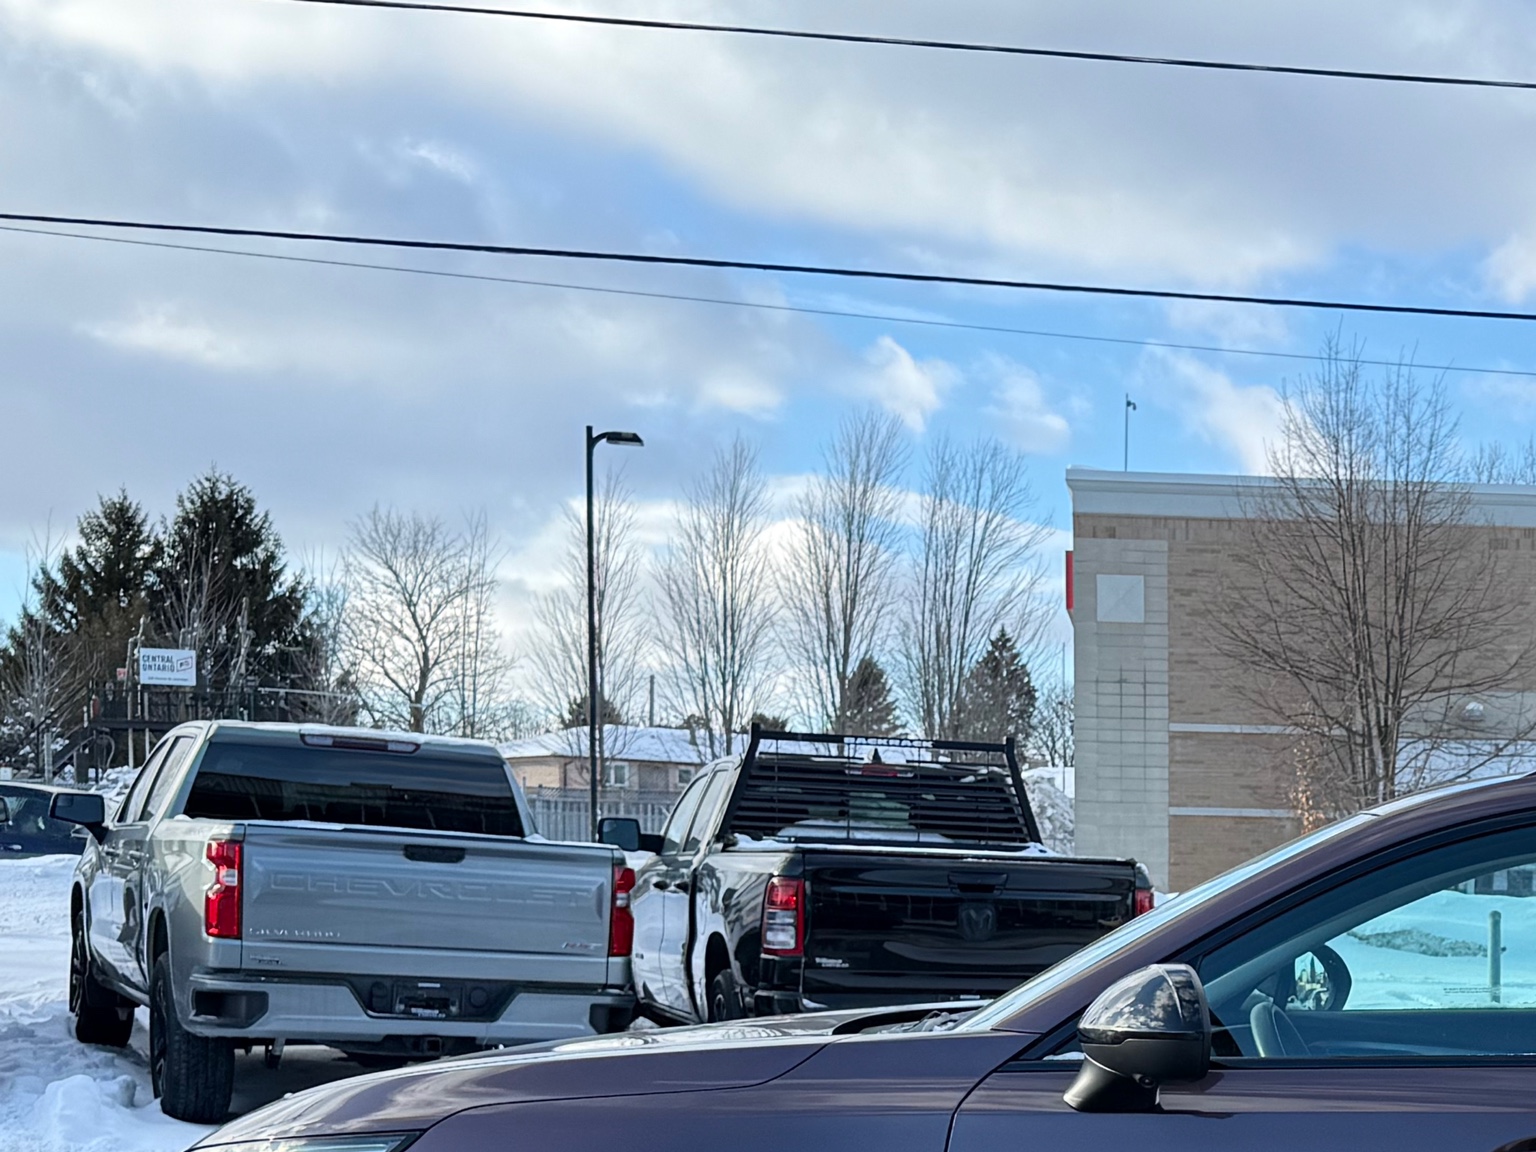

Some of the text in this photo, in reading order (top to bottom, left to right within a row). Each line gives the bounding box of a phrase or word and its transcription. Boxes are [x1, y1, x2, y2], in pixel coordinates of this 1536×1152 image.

[142, 655, 173, 664] CENTRAL
[142, 663, 175, 673] ONTARIO
[270, 873, 591, 907] CHEVROLET
